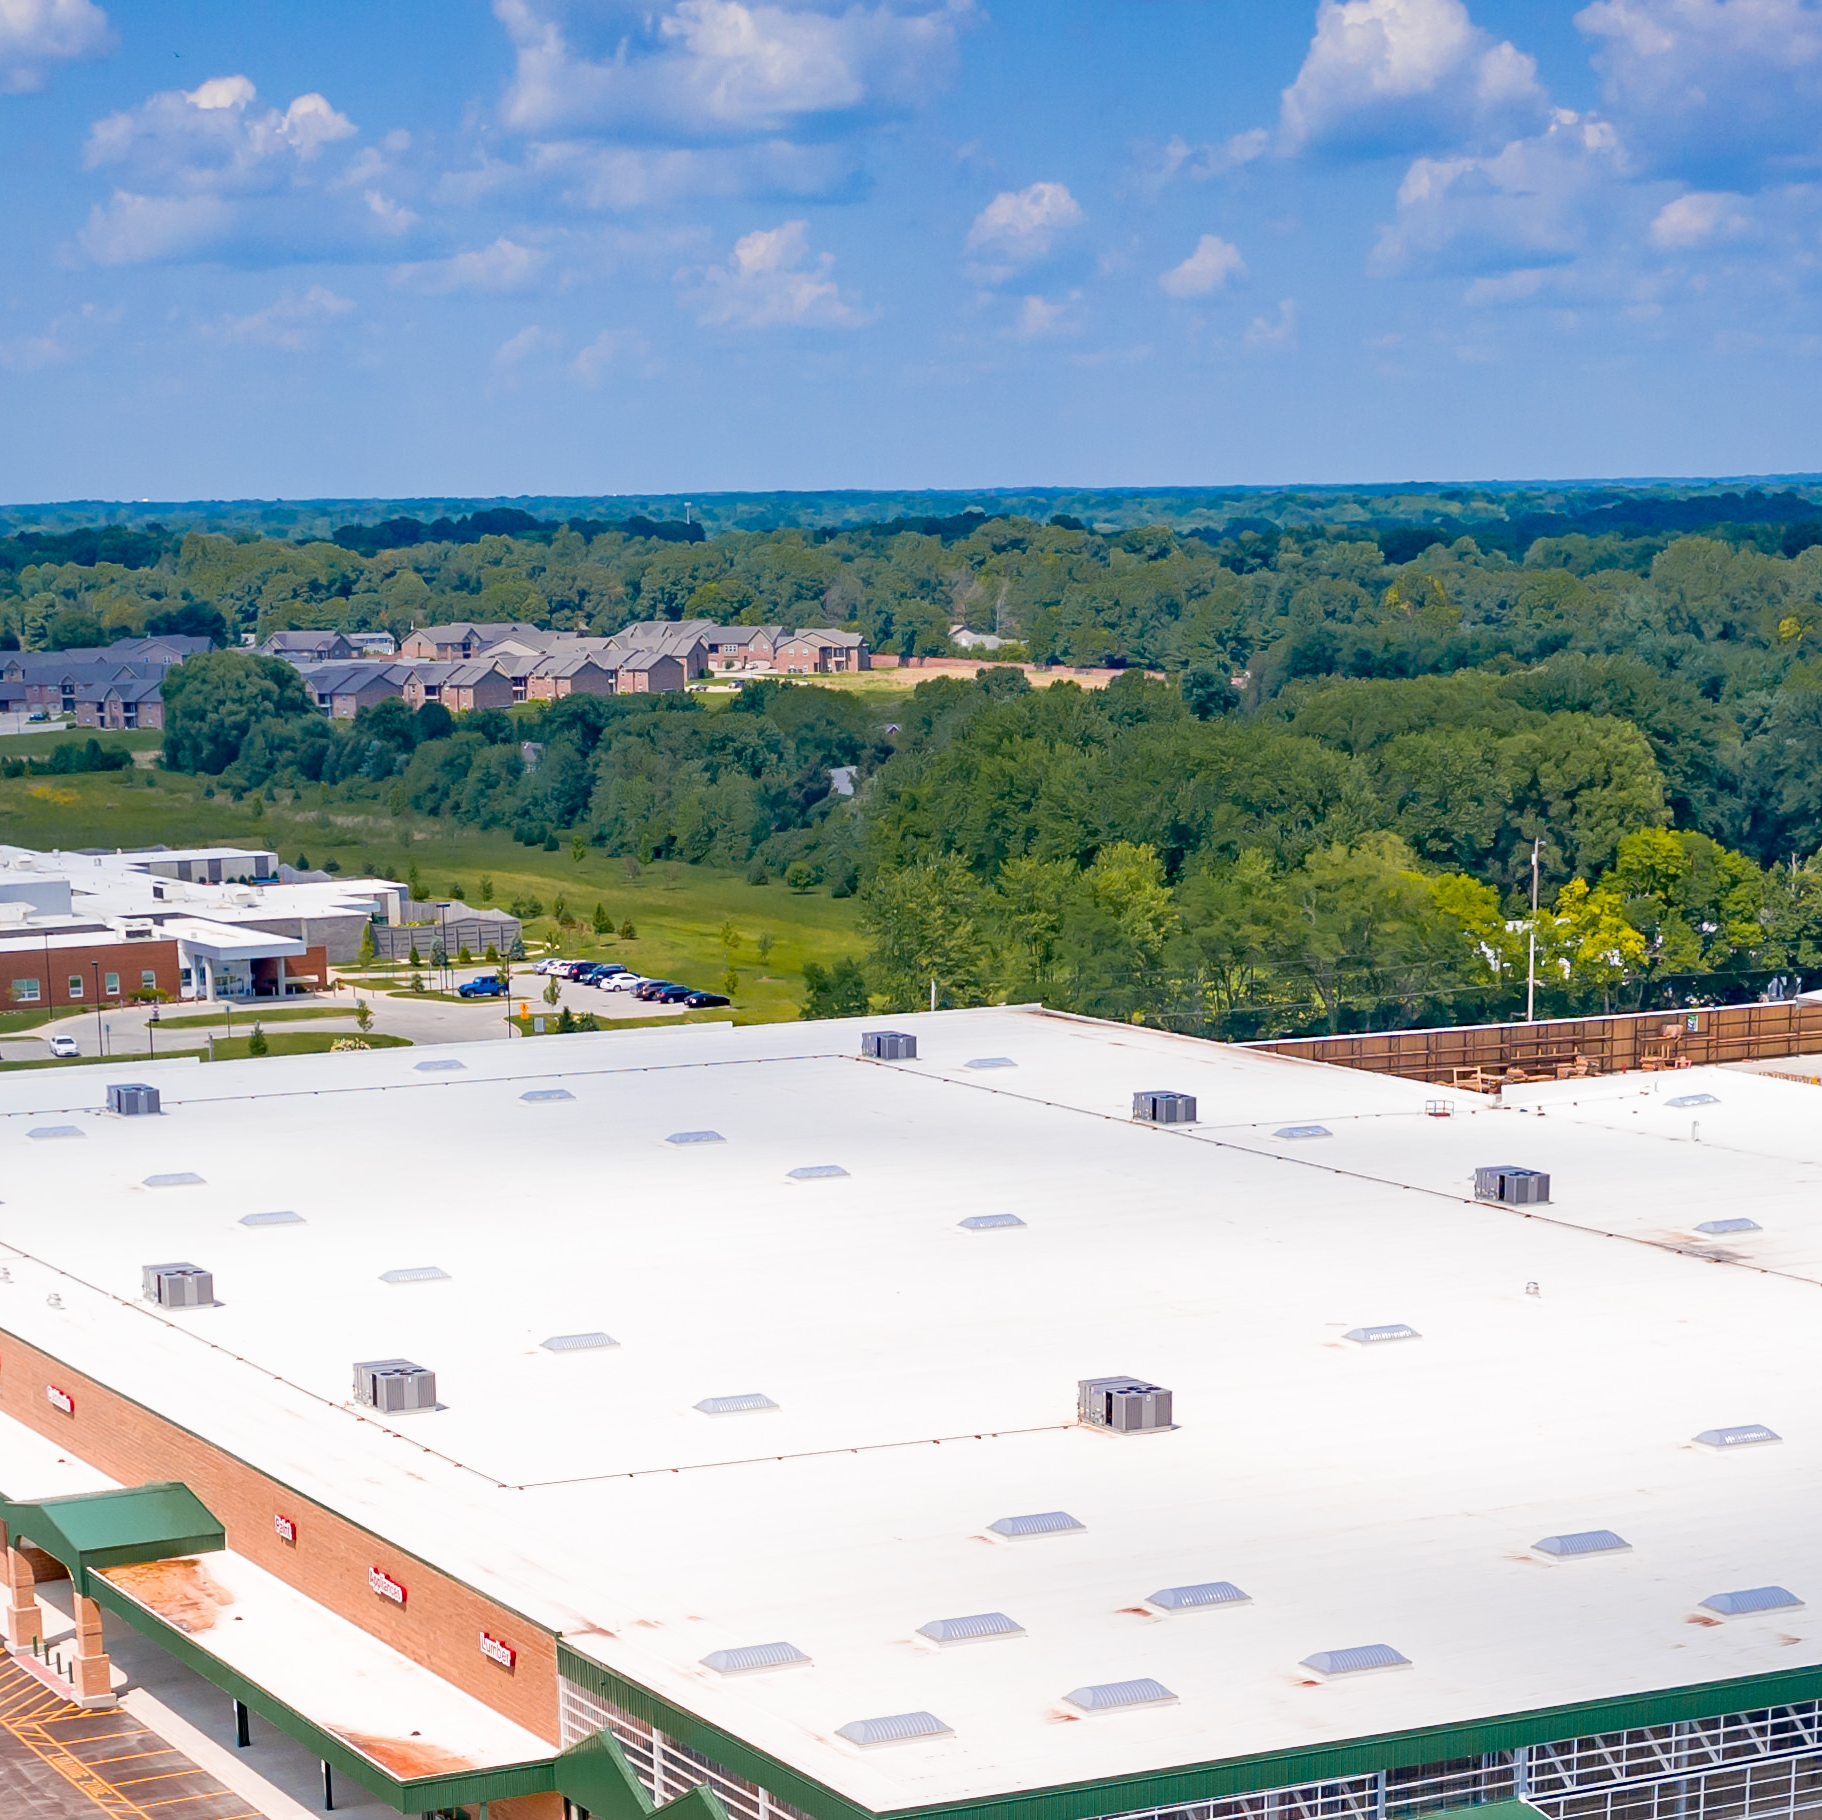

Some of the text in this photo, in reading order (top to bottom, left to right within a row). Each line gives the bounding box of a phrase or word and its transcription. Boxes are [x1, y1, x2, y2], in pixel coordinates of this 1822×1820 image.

[274, 1514, 293, 1541] Paint
[368, 1566, 404, 1603] Appliances
[480, 1631, 512, 1667] Lumber
